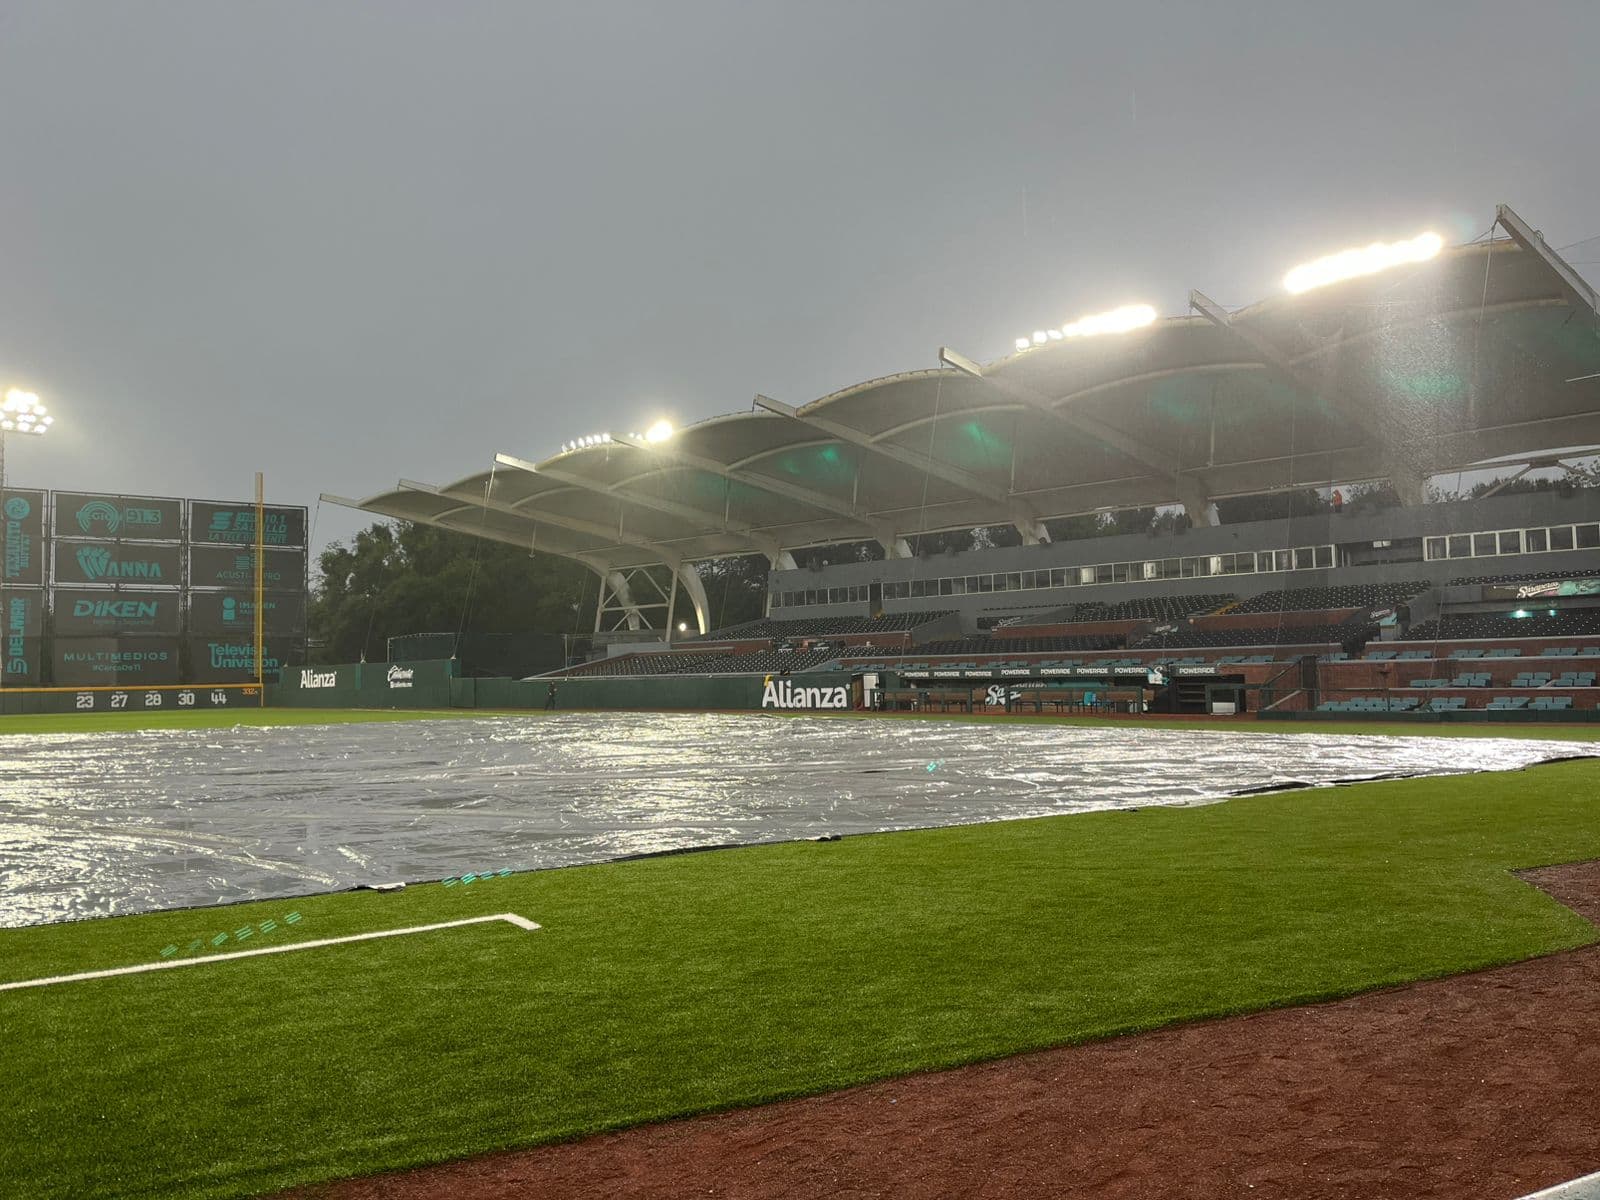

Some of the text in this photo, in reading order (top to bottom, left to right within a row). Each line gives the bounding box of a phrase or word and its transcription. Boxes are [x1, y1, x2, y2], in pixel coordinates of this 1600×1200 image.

[73, 599, 158, 618] DIKEN
[8, 598, 25, 657] DELMAR
[64, 652, 168, 663] MULTIMEDIOS
[210, 655, 278, 668] Univison
[300, 669, 336, 689] Alianza
[145, 694, 162, 706] 28
[178, 692, 195, 706] 30
[211, 692, 227, 704] 44
[761, 679, 848, 708] Alianza
[76, 695, 94, 708] 23
[111, 694, 128, 708] 27
